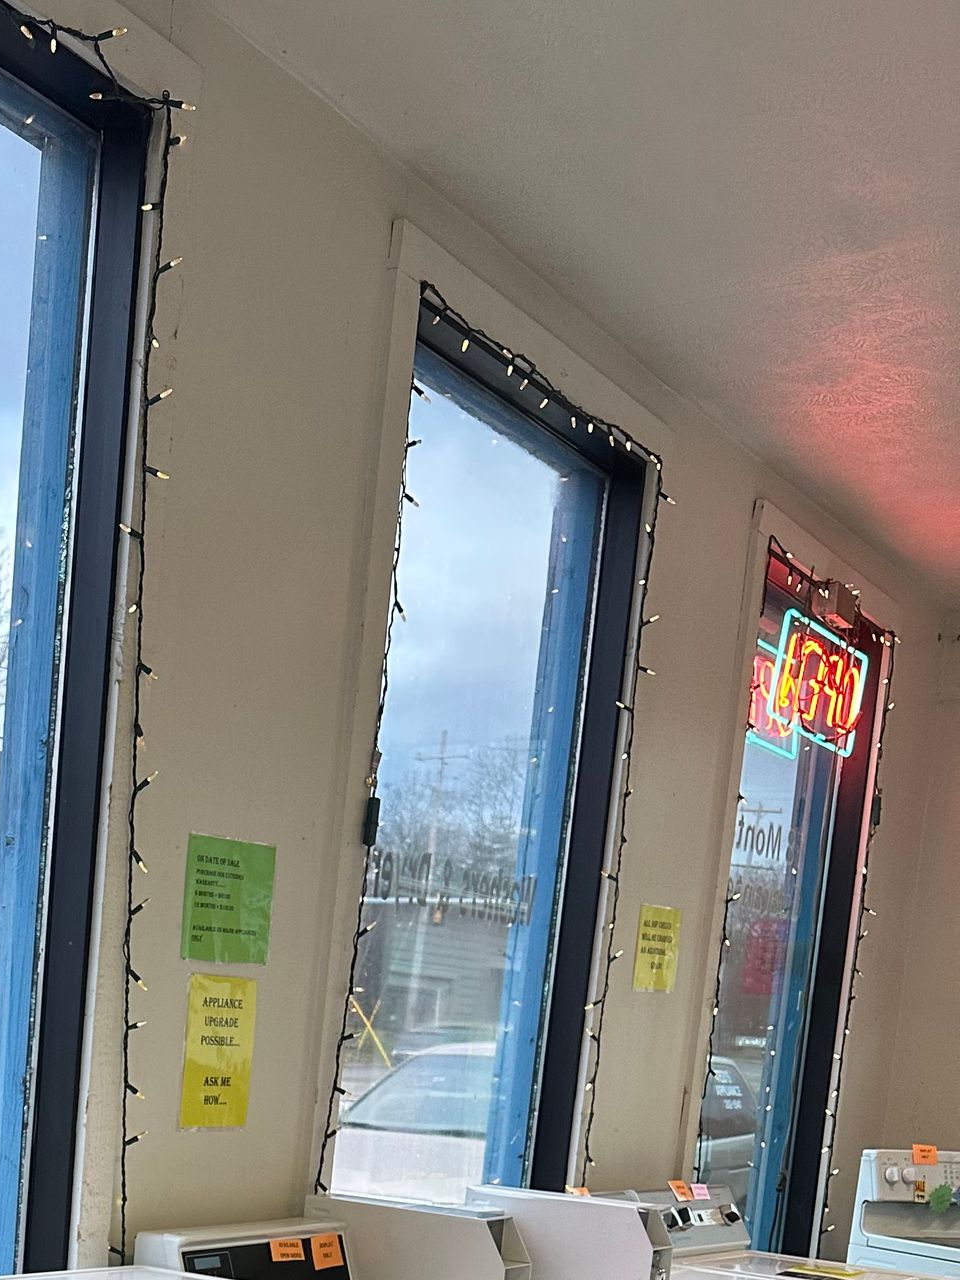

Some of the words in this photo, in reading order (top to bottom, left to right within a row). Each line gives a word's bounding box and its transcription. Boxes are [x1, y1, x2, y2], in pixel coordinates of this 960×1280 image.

[203, 997, 242, 1009] APPLIANCE
[205, 1016, 238, 1028] UPGRADE
[204, 1077, 218, 1086] ASK
[220, 1077, 231, 1086] ME
